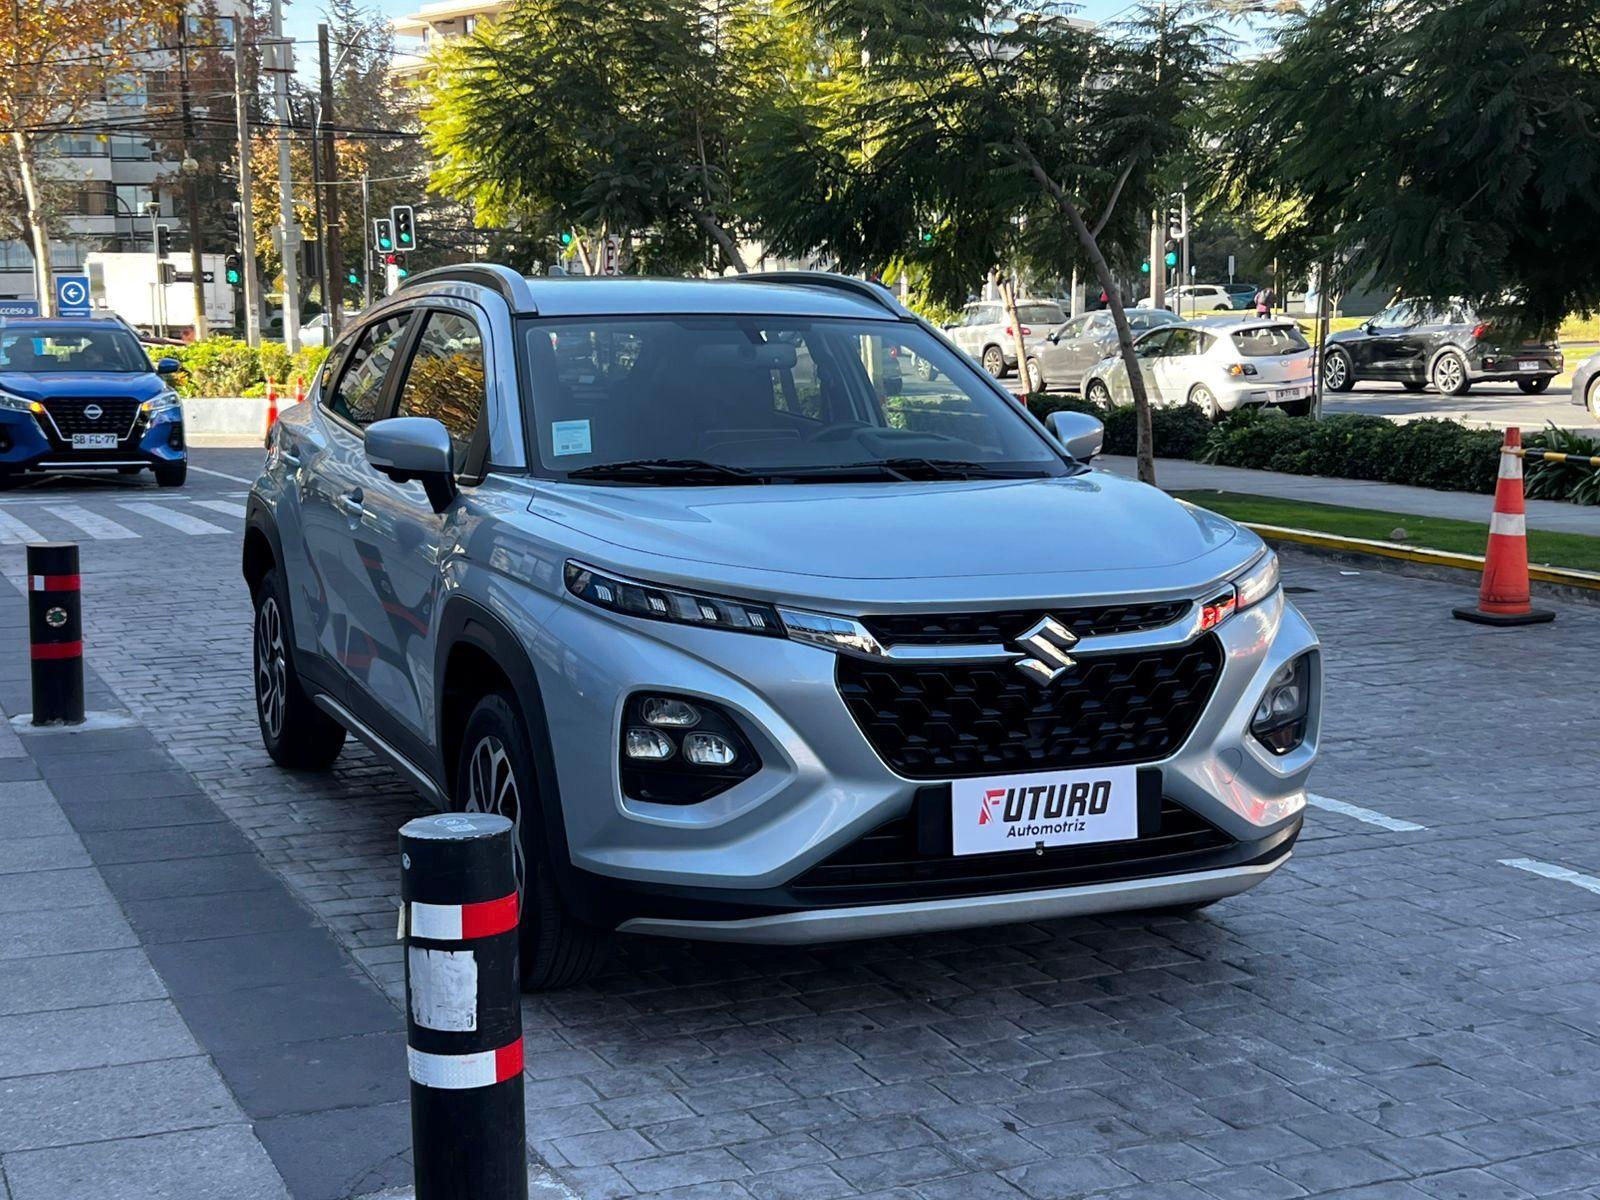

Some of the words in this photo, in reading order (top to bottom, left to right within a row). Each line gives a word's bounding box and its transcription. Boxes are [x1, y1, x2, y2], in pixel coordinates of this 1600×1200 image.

[0, 307, 26, 315] cceso
[27, 307, 34, 315] a
[978, 780, 1112, 825] FUTURO
[1006, 818, 1086, 839] Automotriz
